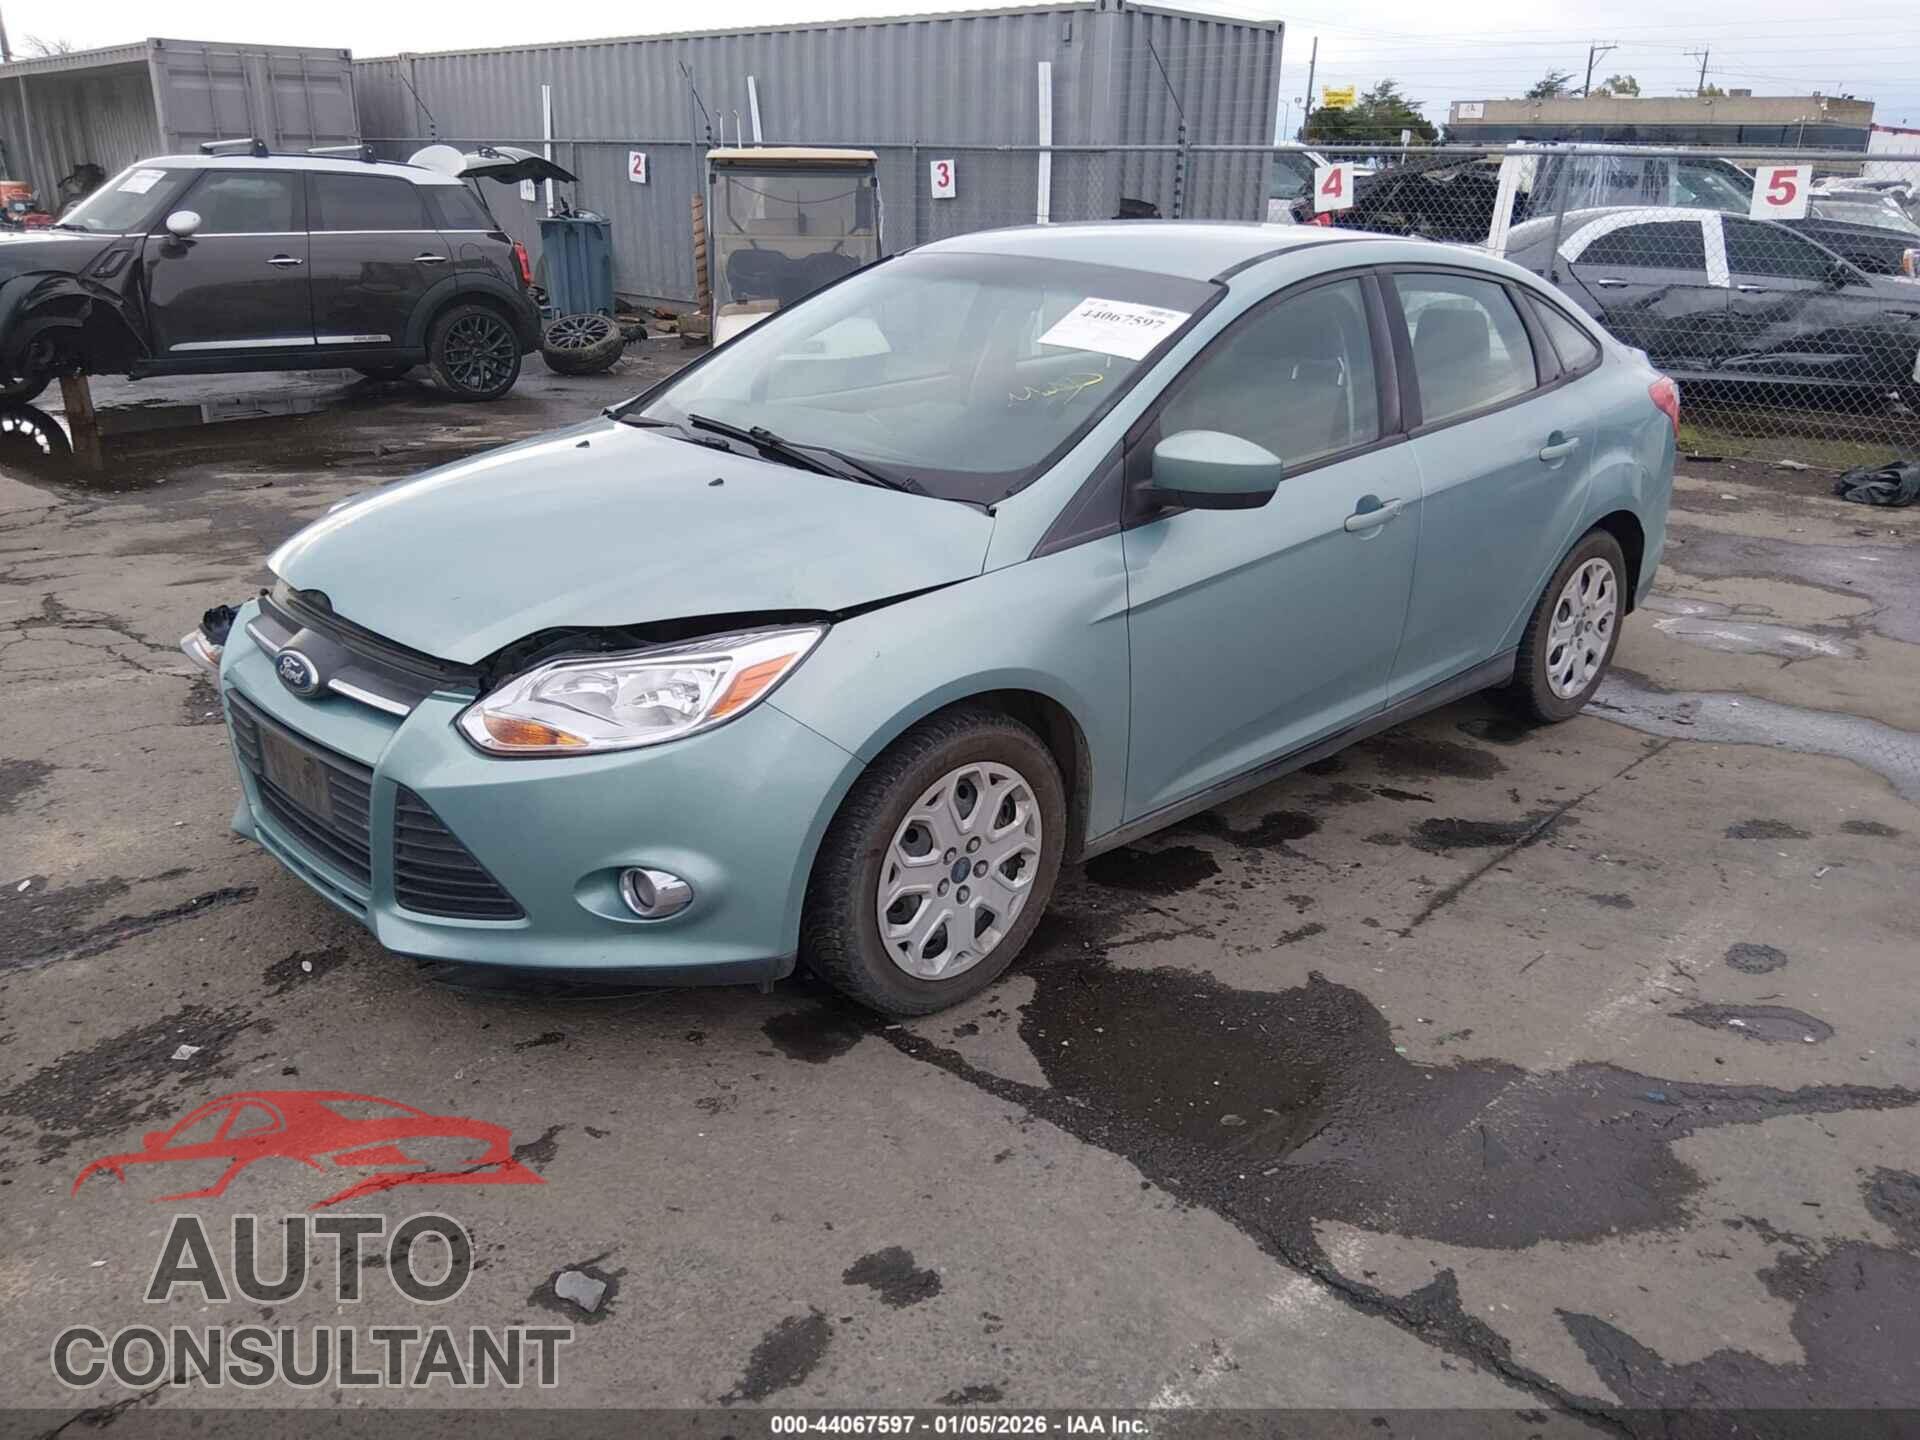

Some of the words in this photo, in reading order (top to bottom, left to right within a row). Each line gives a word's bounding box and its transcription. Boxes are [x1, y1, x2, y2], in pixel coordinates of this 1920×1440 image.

[633, 154, 642, 175] 2
[937, 162, 950, 188] 3
[1321, 167, 1343, 198] 4
[1766, 169, 1798, 206] 5
